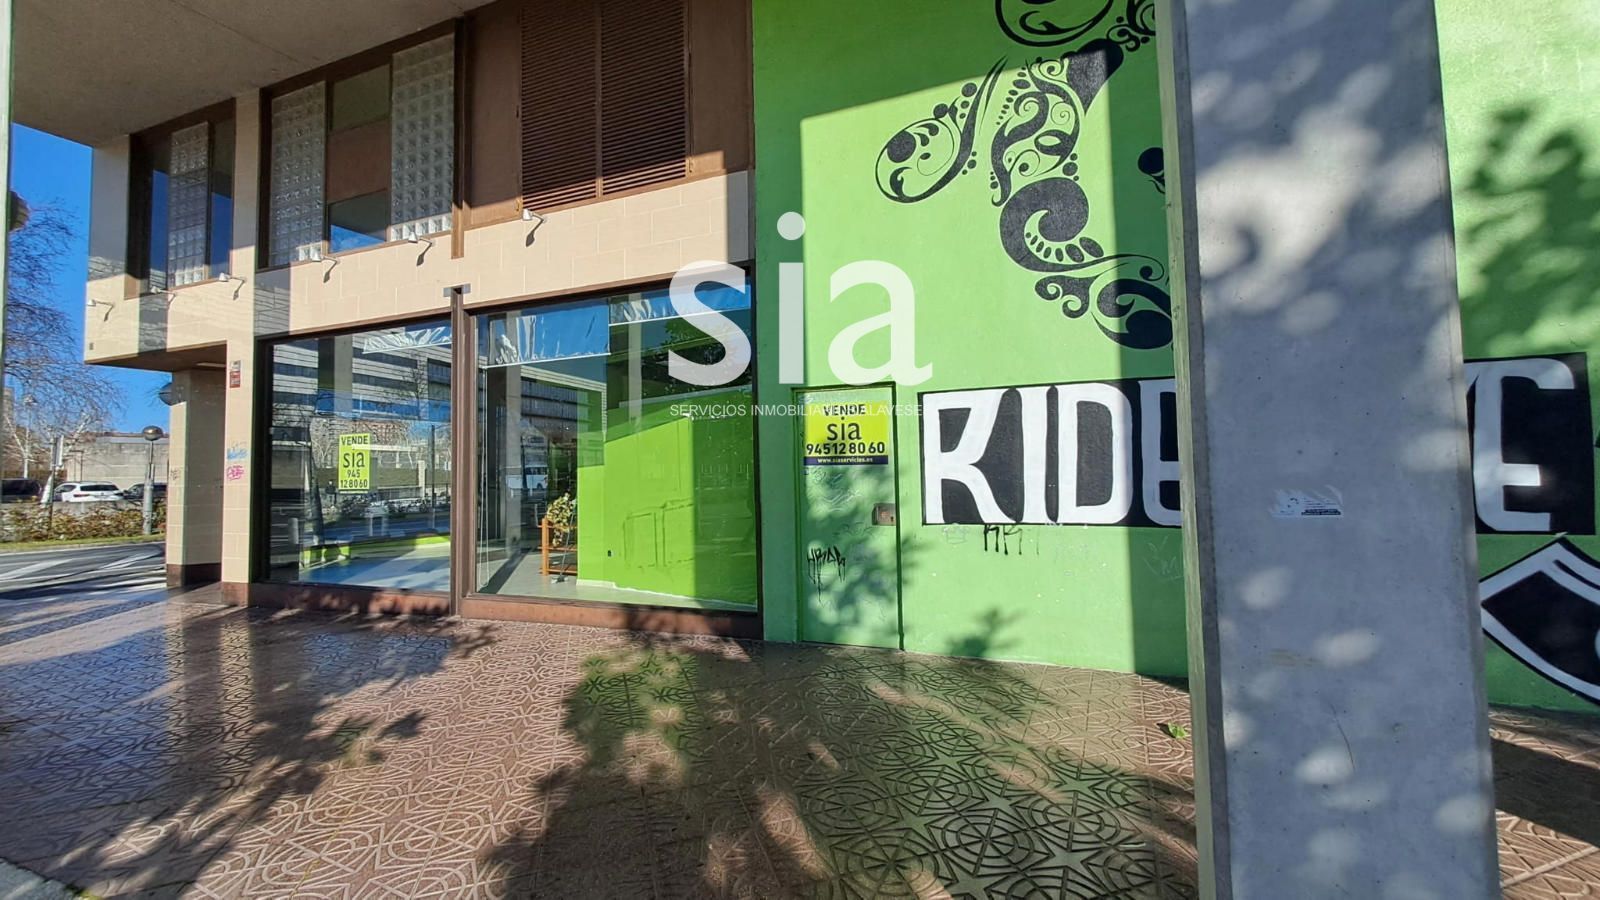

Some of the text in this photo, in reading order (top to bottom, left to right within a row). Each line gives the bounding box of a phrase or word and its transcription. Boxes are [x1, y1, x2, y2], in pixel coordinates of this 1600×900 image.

[823, 403, 866, 416] VENDE
[826, 416, 862, 441] sia
[341, 435, 369, 446] VENDE
[343, 447, 365, 468] sia
[347, 469, 361, 478] 945
